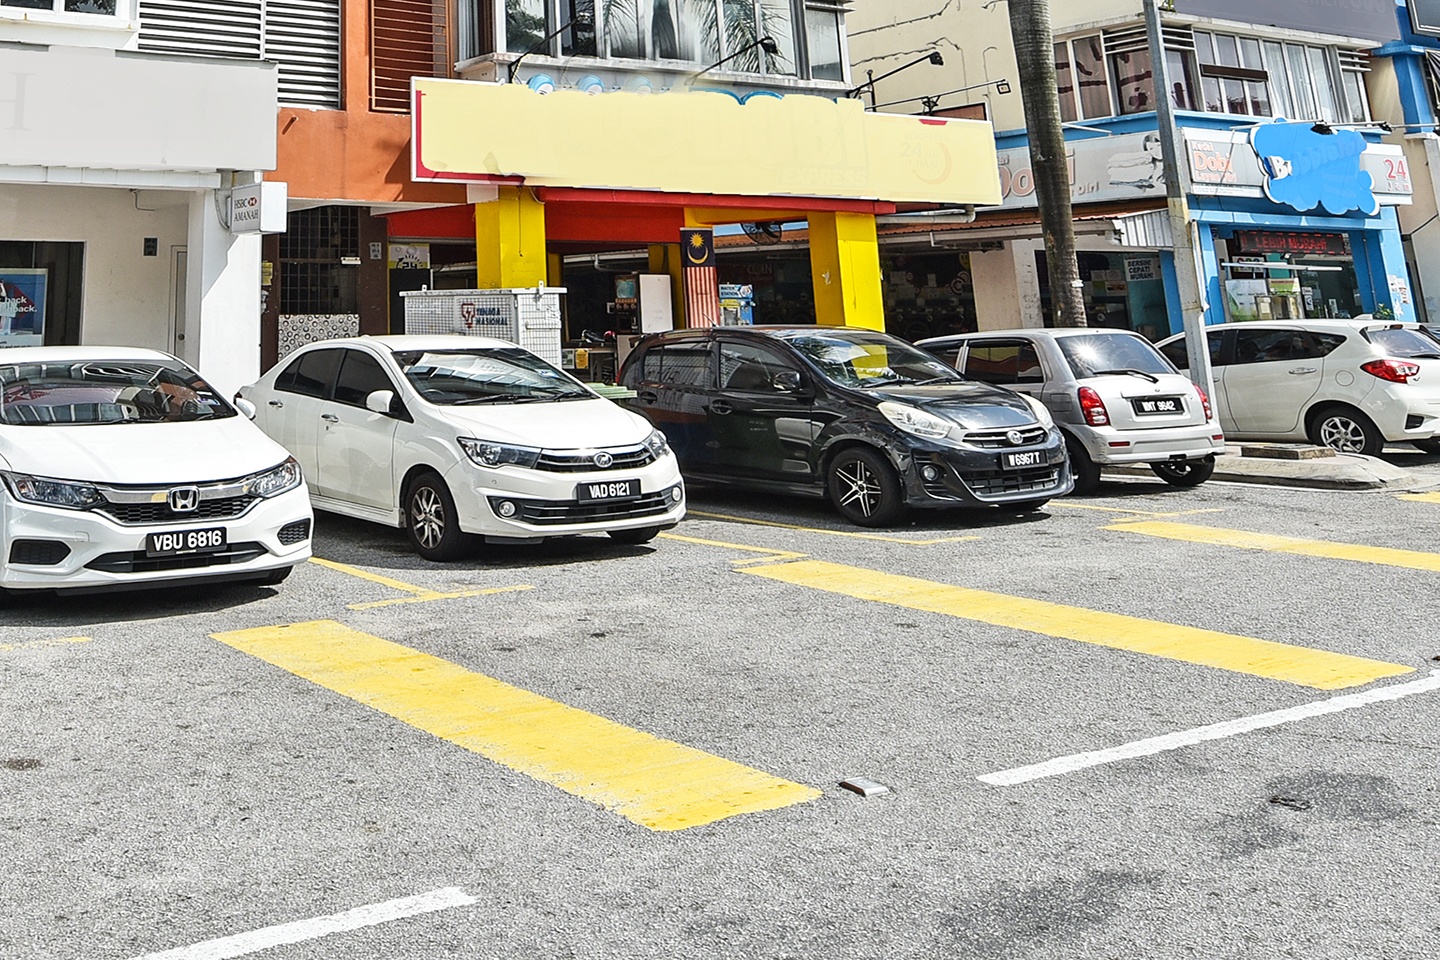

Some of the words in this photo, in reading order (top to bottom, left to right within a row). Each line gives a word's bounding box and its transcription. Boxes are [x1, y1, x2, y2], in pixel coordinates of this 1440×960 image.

[1193, 151, 1233, 173] Dobi
[1384, 158, 1408, 180] 24
[233, 198, 248, 209] HSBC
[233, 209, 260, 223] AMANAH
[4, 296, 27, 305] back
[475, 317, 508, 326] NASIONAL
[589, 484, 608, 498] VAD
[609, 482, 630, 497] 6121
[153, 532, 184, 552] VBU
[186, 529, 223, 548] 6816
